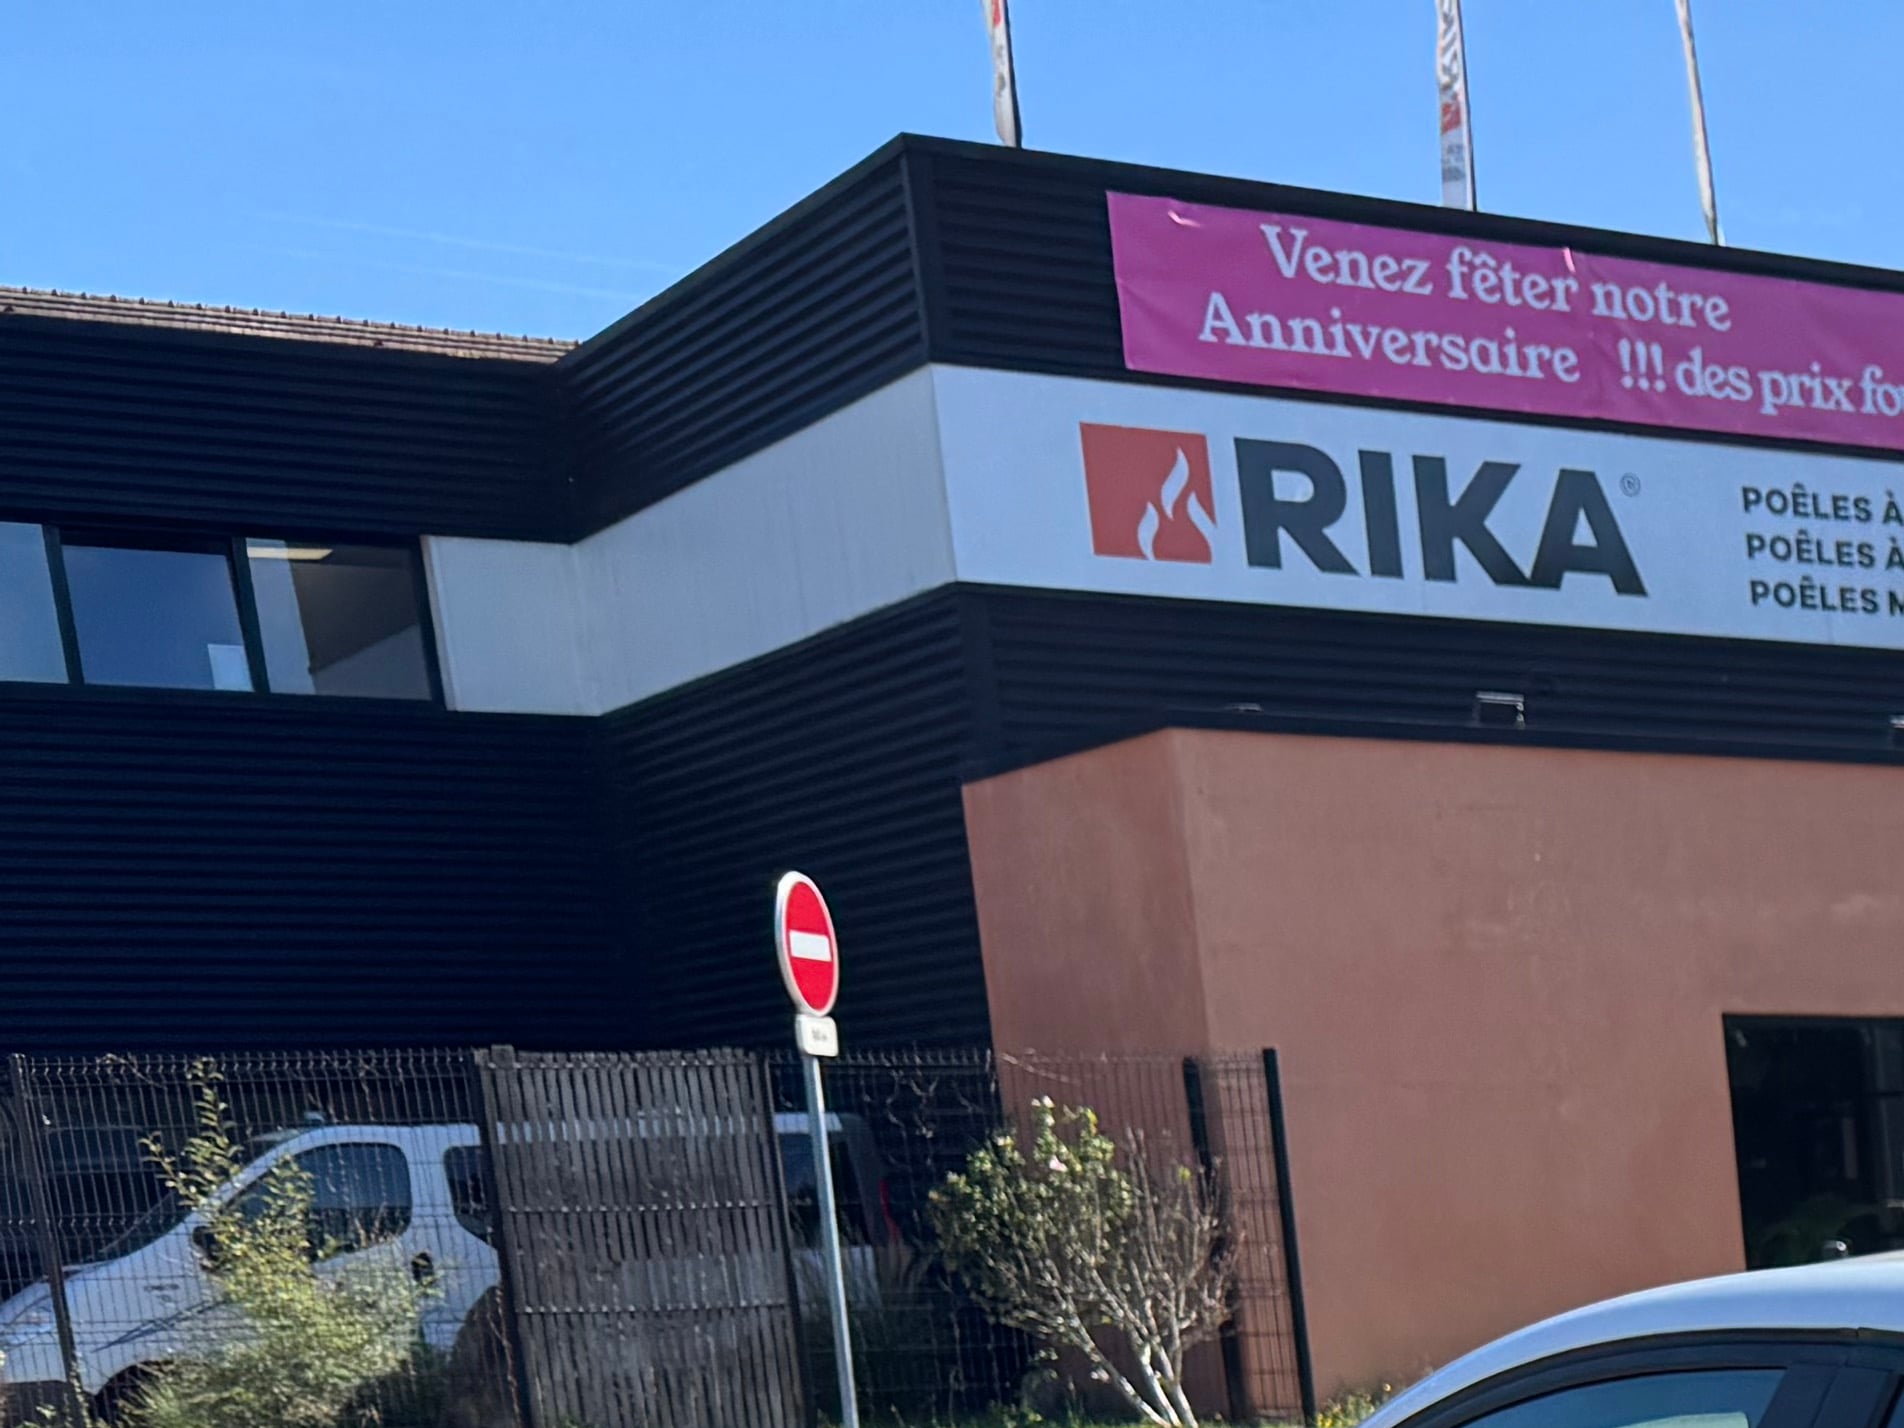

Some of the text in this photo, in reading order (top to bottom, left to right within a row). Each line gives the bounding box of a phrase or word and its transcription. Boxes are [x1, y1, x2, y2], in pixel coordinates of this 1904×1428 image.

[1260, 223, 1732, 332] Venez fêter notre
[1198, 291, 1581, 382] Anniversaire
[1674, 346, 1753, 401] des
[1757, 361, 1857, 416] prix
[1232, 436, 1649, 598] RIKA
[1741, 482, 1873, 525] POÊLES
[1882, 489, 1904, 527] À
[1746, 528, 1876, 570] POÊLES
[1749, 575, 1880, 615] POÊLES
